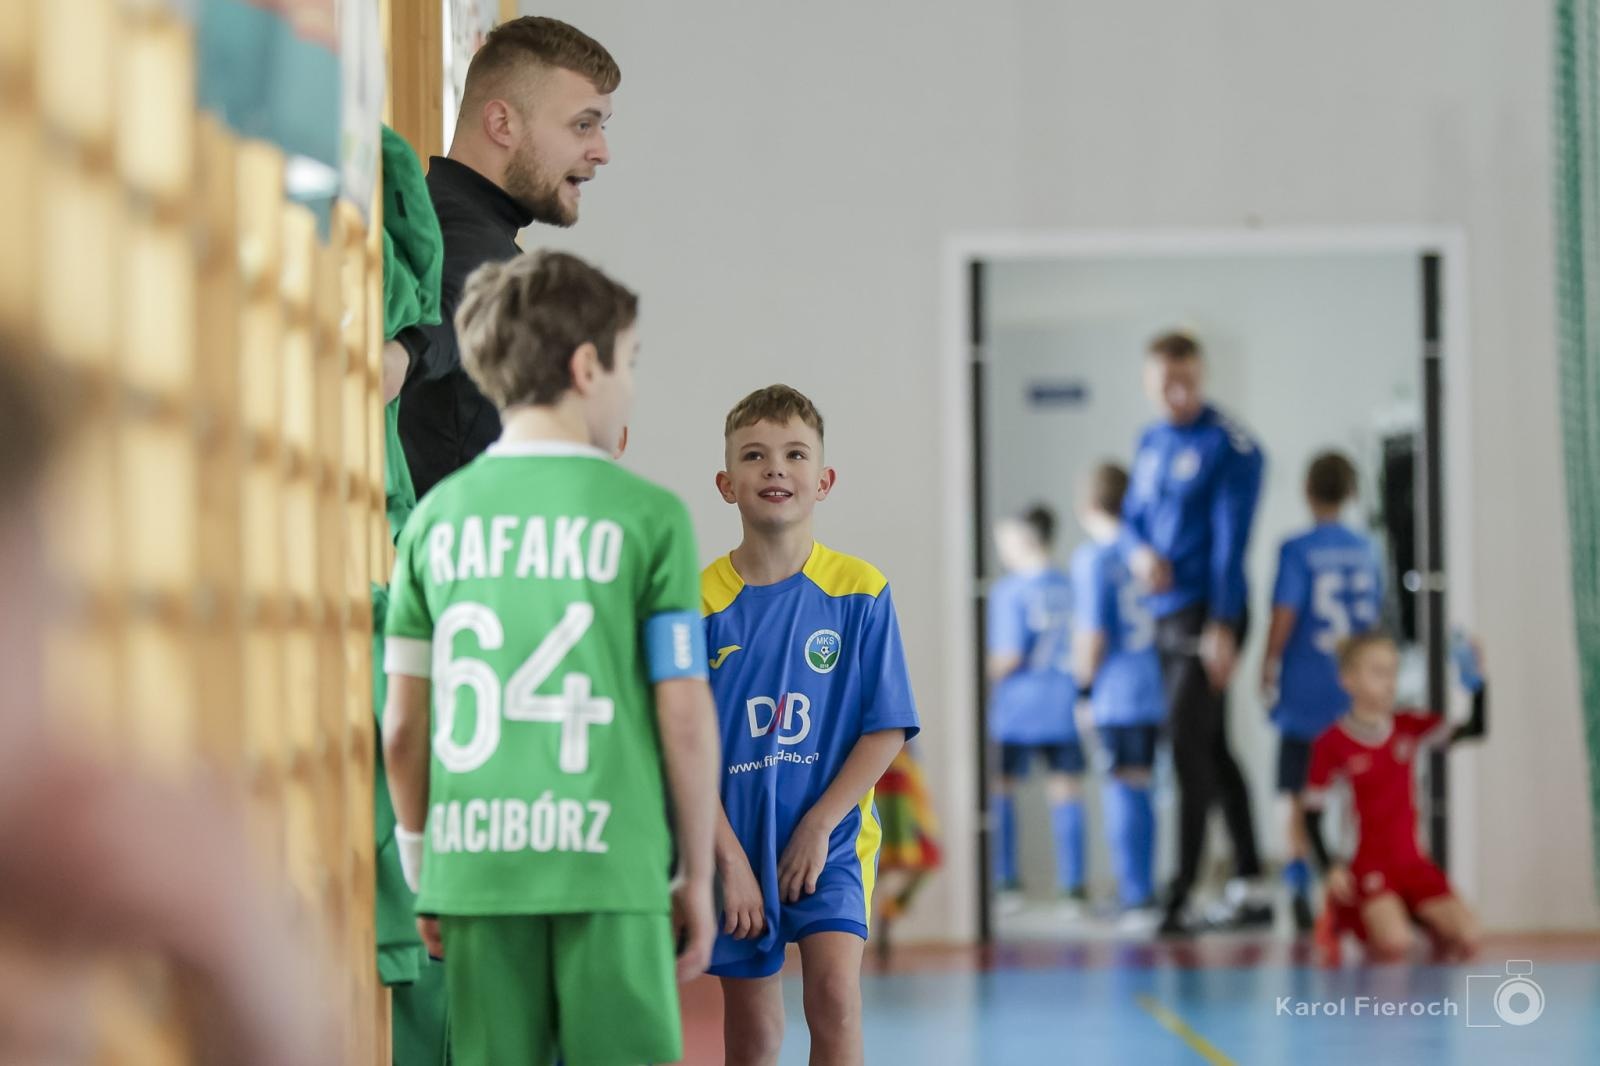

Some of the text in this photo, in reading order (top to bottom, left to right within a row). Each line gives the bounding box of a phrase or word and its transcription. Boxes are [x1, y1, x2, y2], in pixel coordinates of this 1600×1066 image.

[429, 515, 624, 584] RAFAKO
[816, 636, 835, 645] MKS
[431, 600, 615, 773] 64
